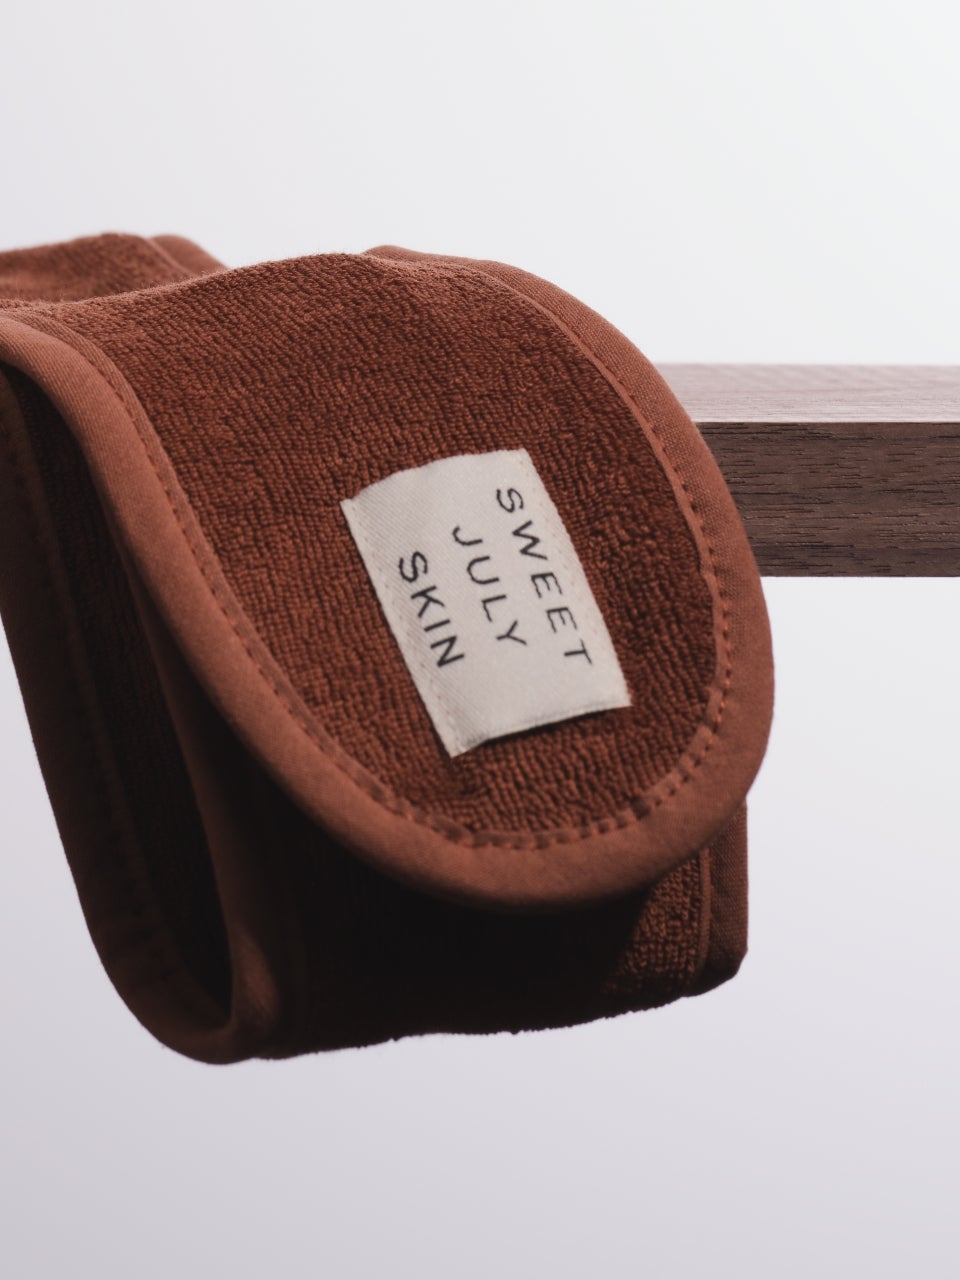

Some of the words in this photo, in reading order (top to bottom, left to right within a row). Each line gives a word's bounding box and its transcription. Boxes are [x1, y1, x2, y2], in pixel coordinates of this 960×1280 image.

[398, 551, 465, 668] SKIN
[452, 526, 528, 647] JULY
[496, 487, 594, 666] SWEET
